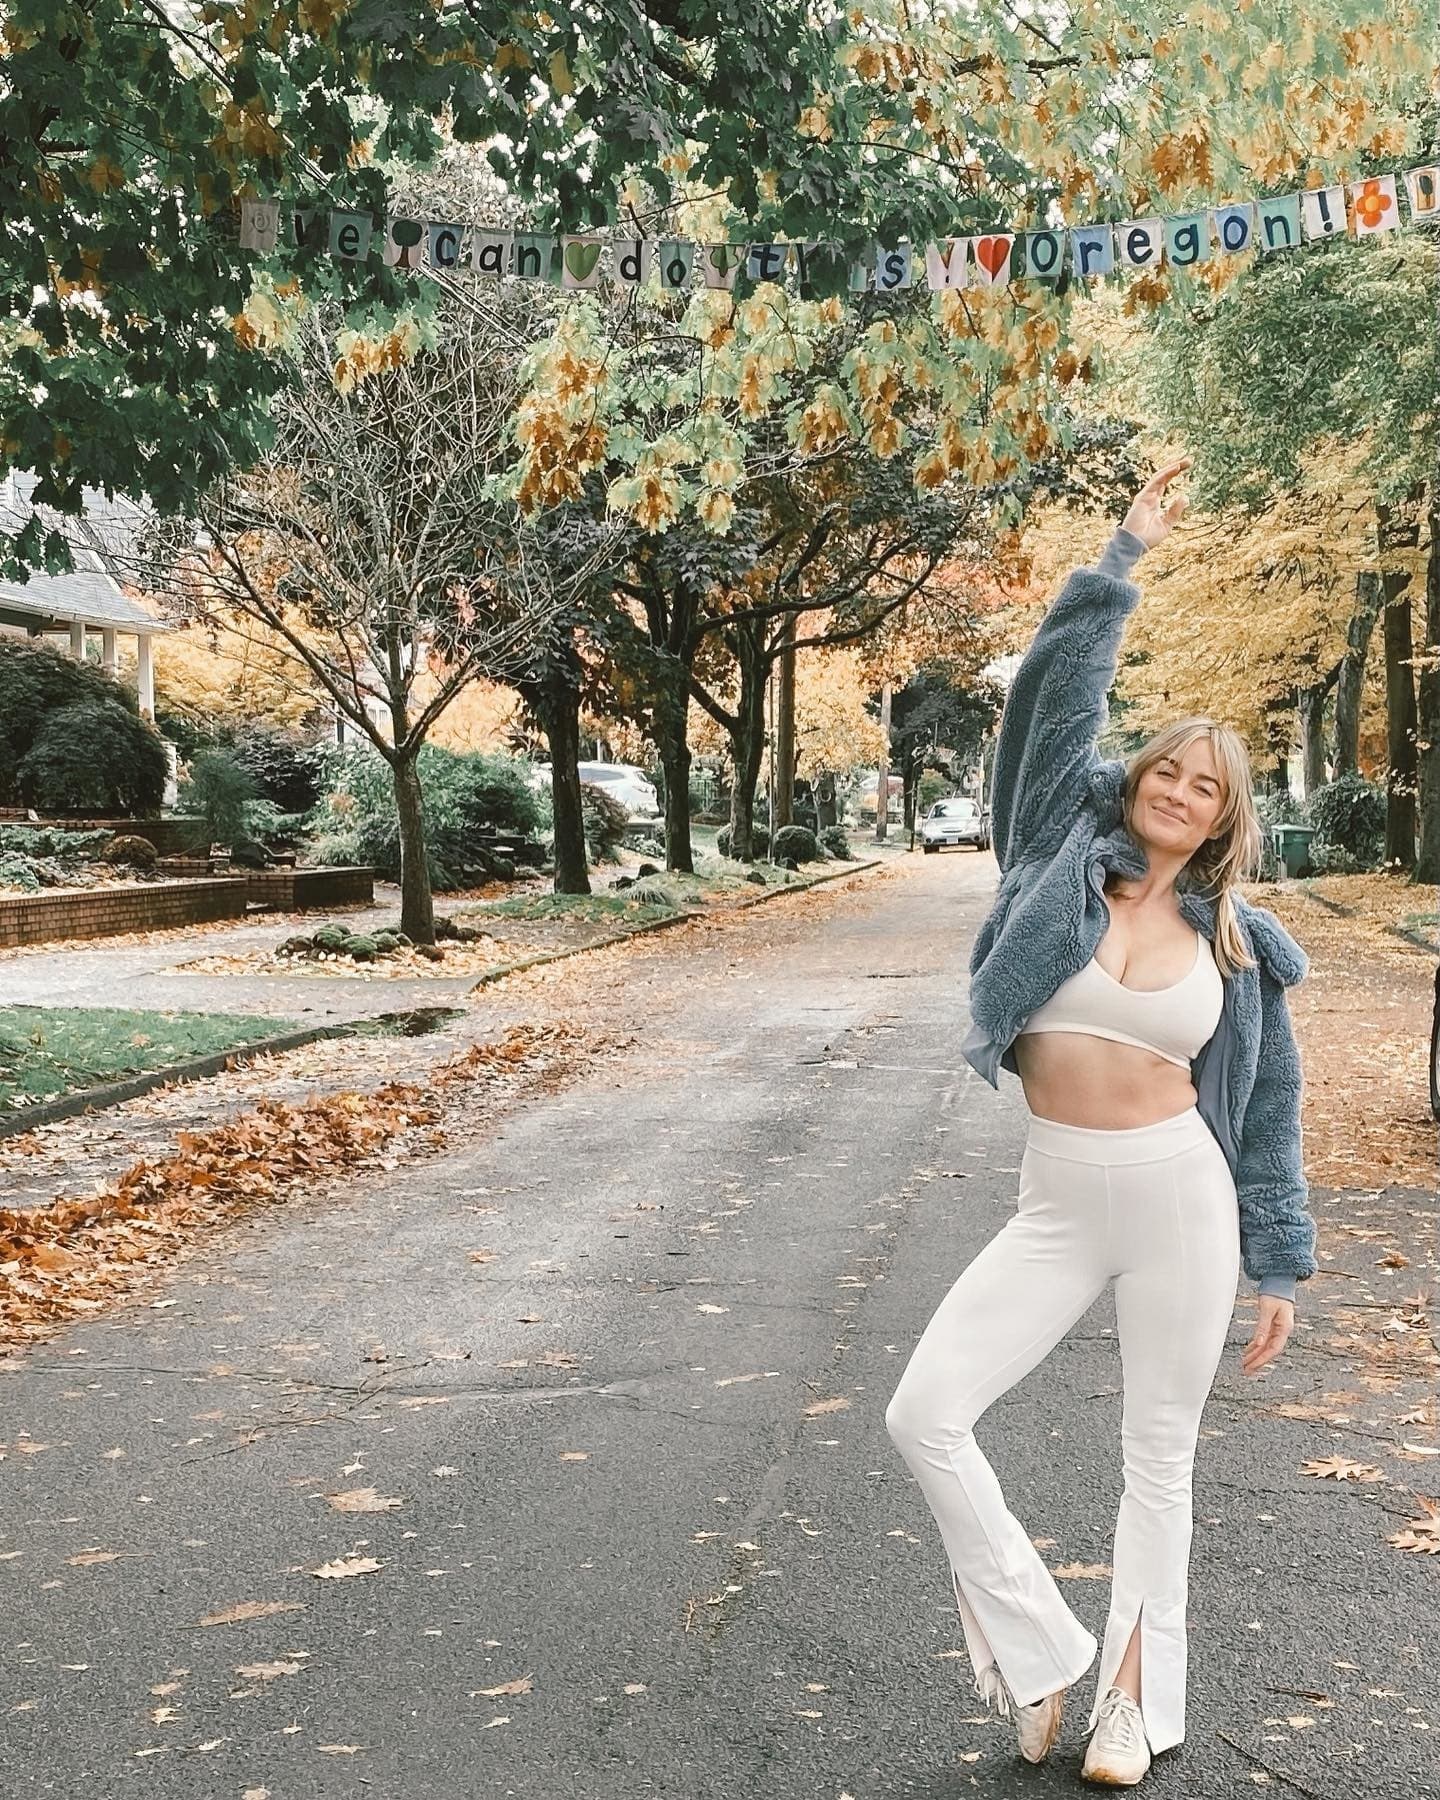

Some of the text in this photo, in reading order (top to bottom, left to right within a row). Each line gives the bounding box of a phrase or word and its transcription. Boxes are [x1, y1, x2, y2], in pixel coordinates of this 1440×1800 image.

[435, 230, 541, 276] can
[620, 240, 687, 287] do
[1031, 190, 1334, 273] Oregon!
